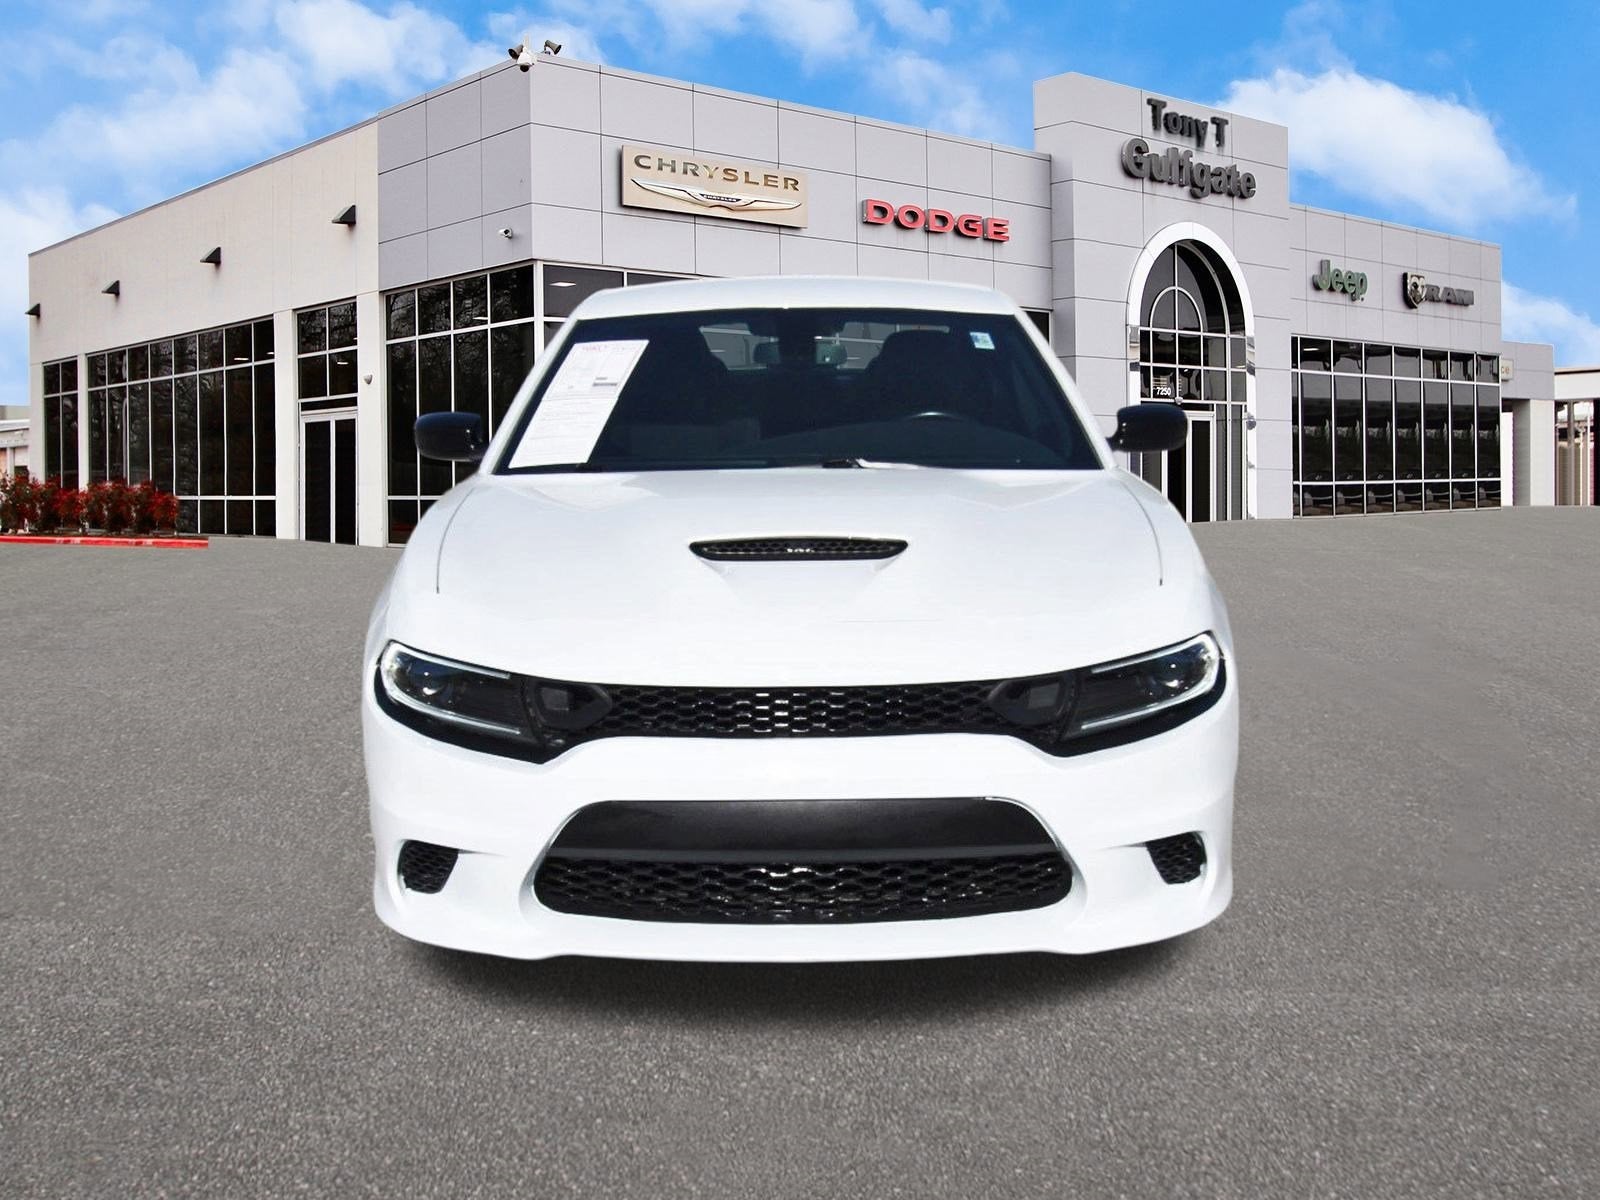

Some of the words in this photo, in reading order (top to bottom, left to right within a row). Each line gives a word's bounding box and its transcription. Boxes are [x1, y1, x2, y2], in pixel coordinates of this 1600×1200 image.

[1146, 98, 1208, 147] Tony
[1210, 116, 1229, 147] T
[633, 154, 800, 192] CHRYSLER
[1121, 138, 1256, 198] Gulfgate
[862, 198, 1011, 242] DODGE
[1312, 259, 1368, 302] Jeep
[1424, 284, 1475, 306] RAM
